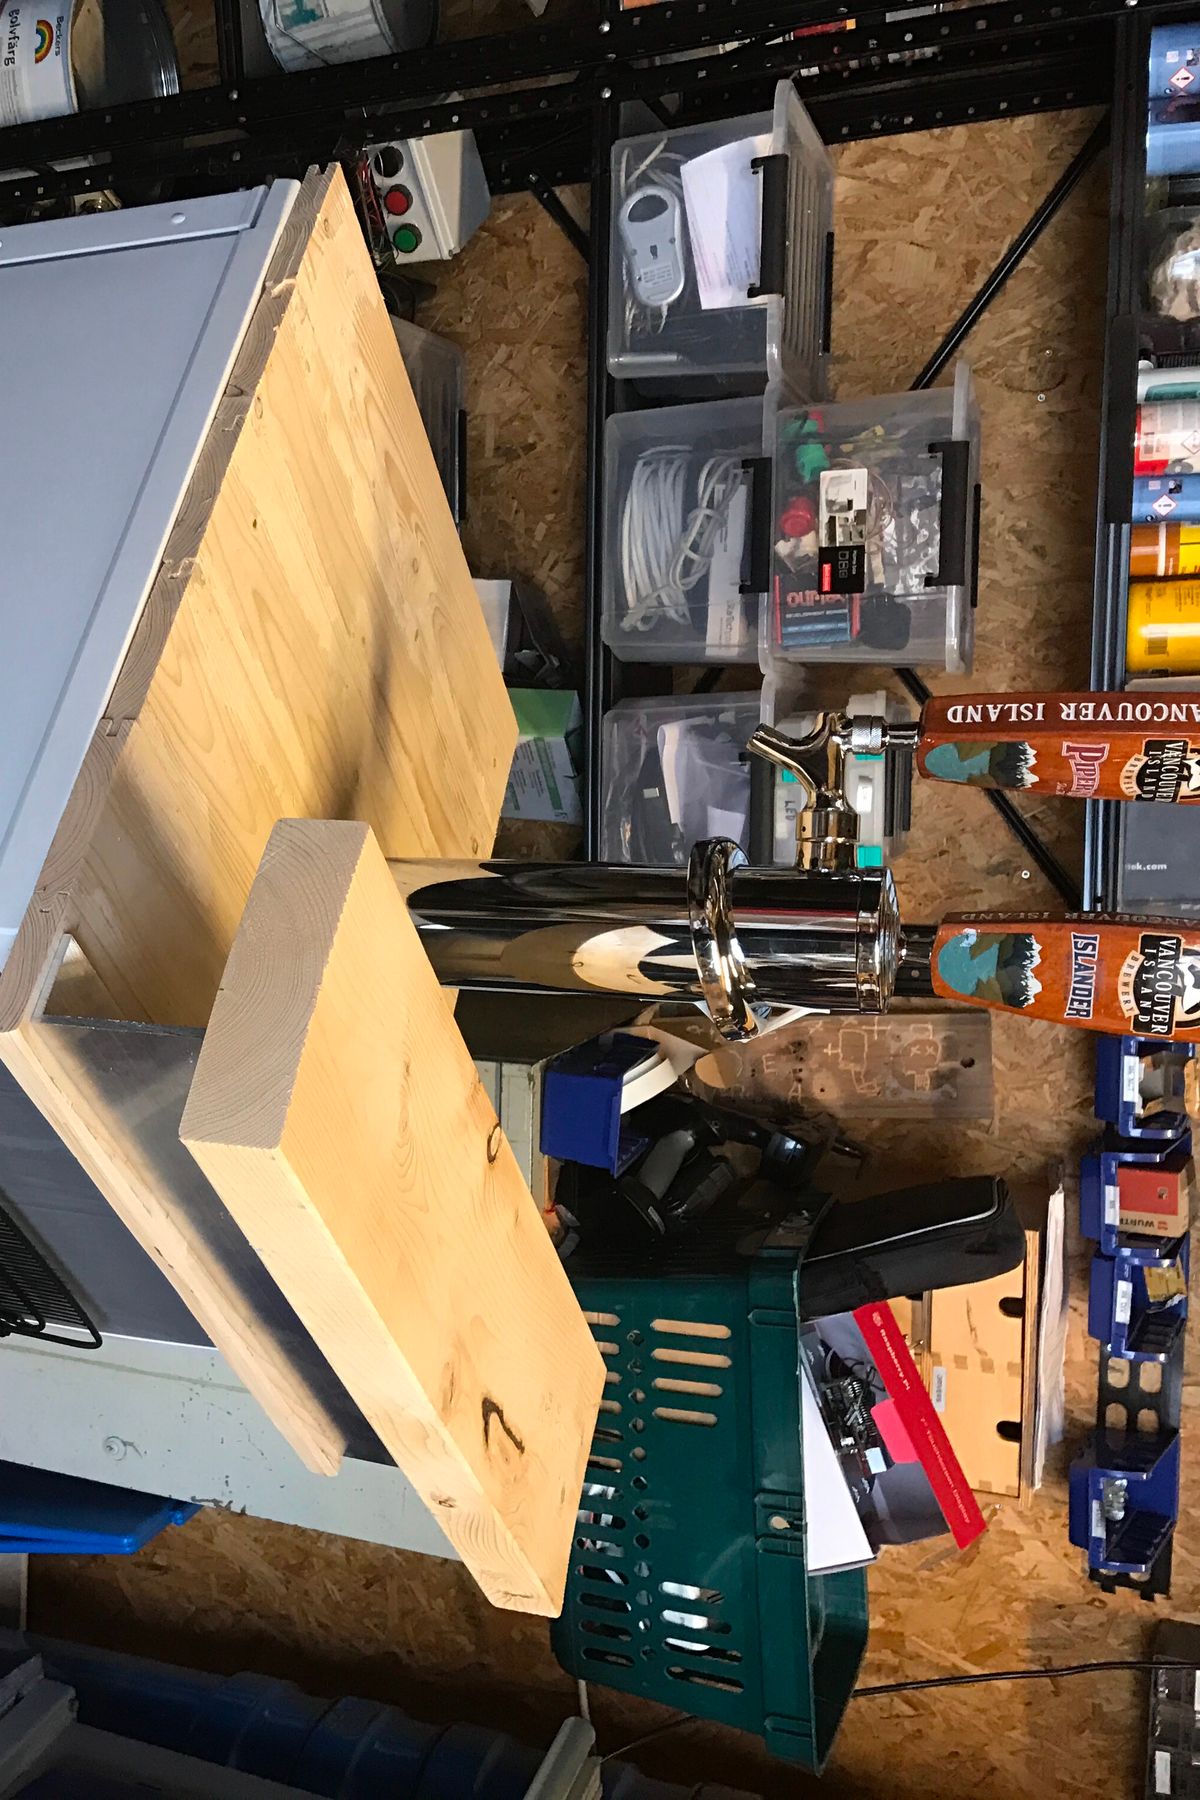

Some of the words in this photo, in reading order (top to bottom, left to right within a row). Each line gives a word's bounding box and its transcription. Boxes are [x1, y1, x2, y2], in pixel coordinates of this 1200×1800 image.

[4, 9, 20, 67] golvfärg
[54, 16, 64, 57] Beckers
[946, 702, 1046, 724] ISLAND
[1141, 751, 1162, 799] ISLAND
[784, 800, 796, 822] LED
[1064, 932, 1100, 1019] ISLANDER
[1121, 954, 1140, 1014] BREWERY
[1138, 948, 1157, 1023] ISLAND
[1150, 939, 1177, 1034] VANCOUVER
[879, 1328, 906, 1378] Raspberry
